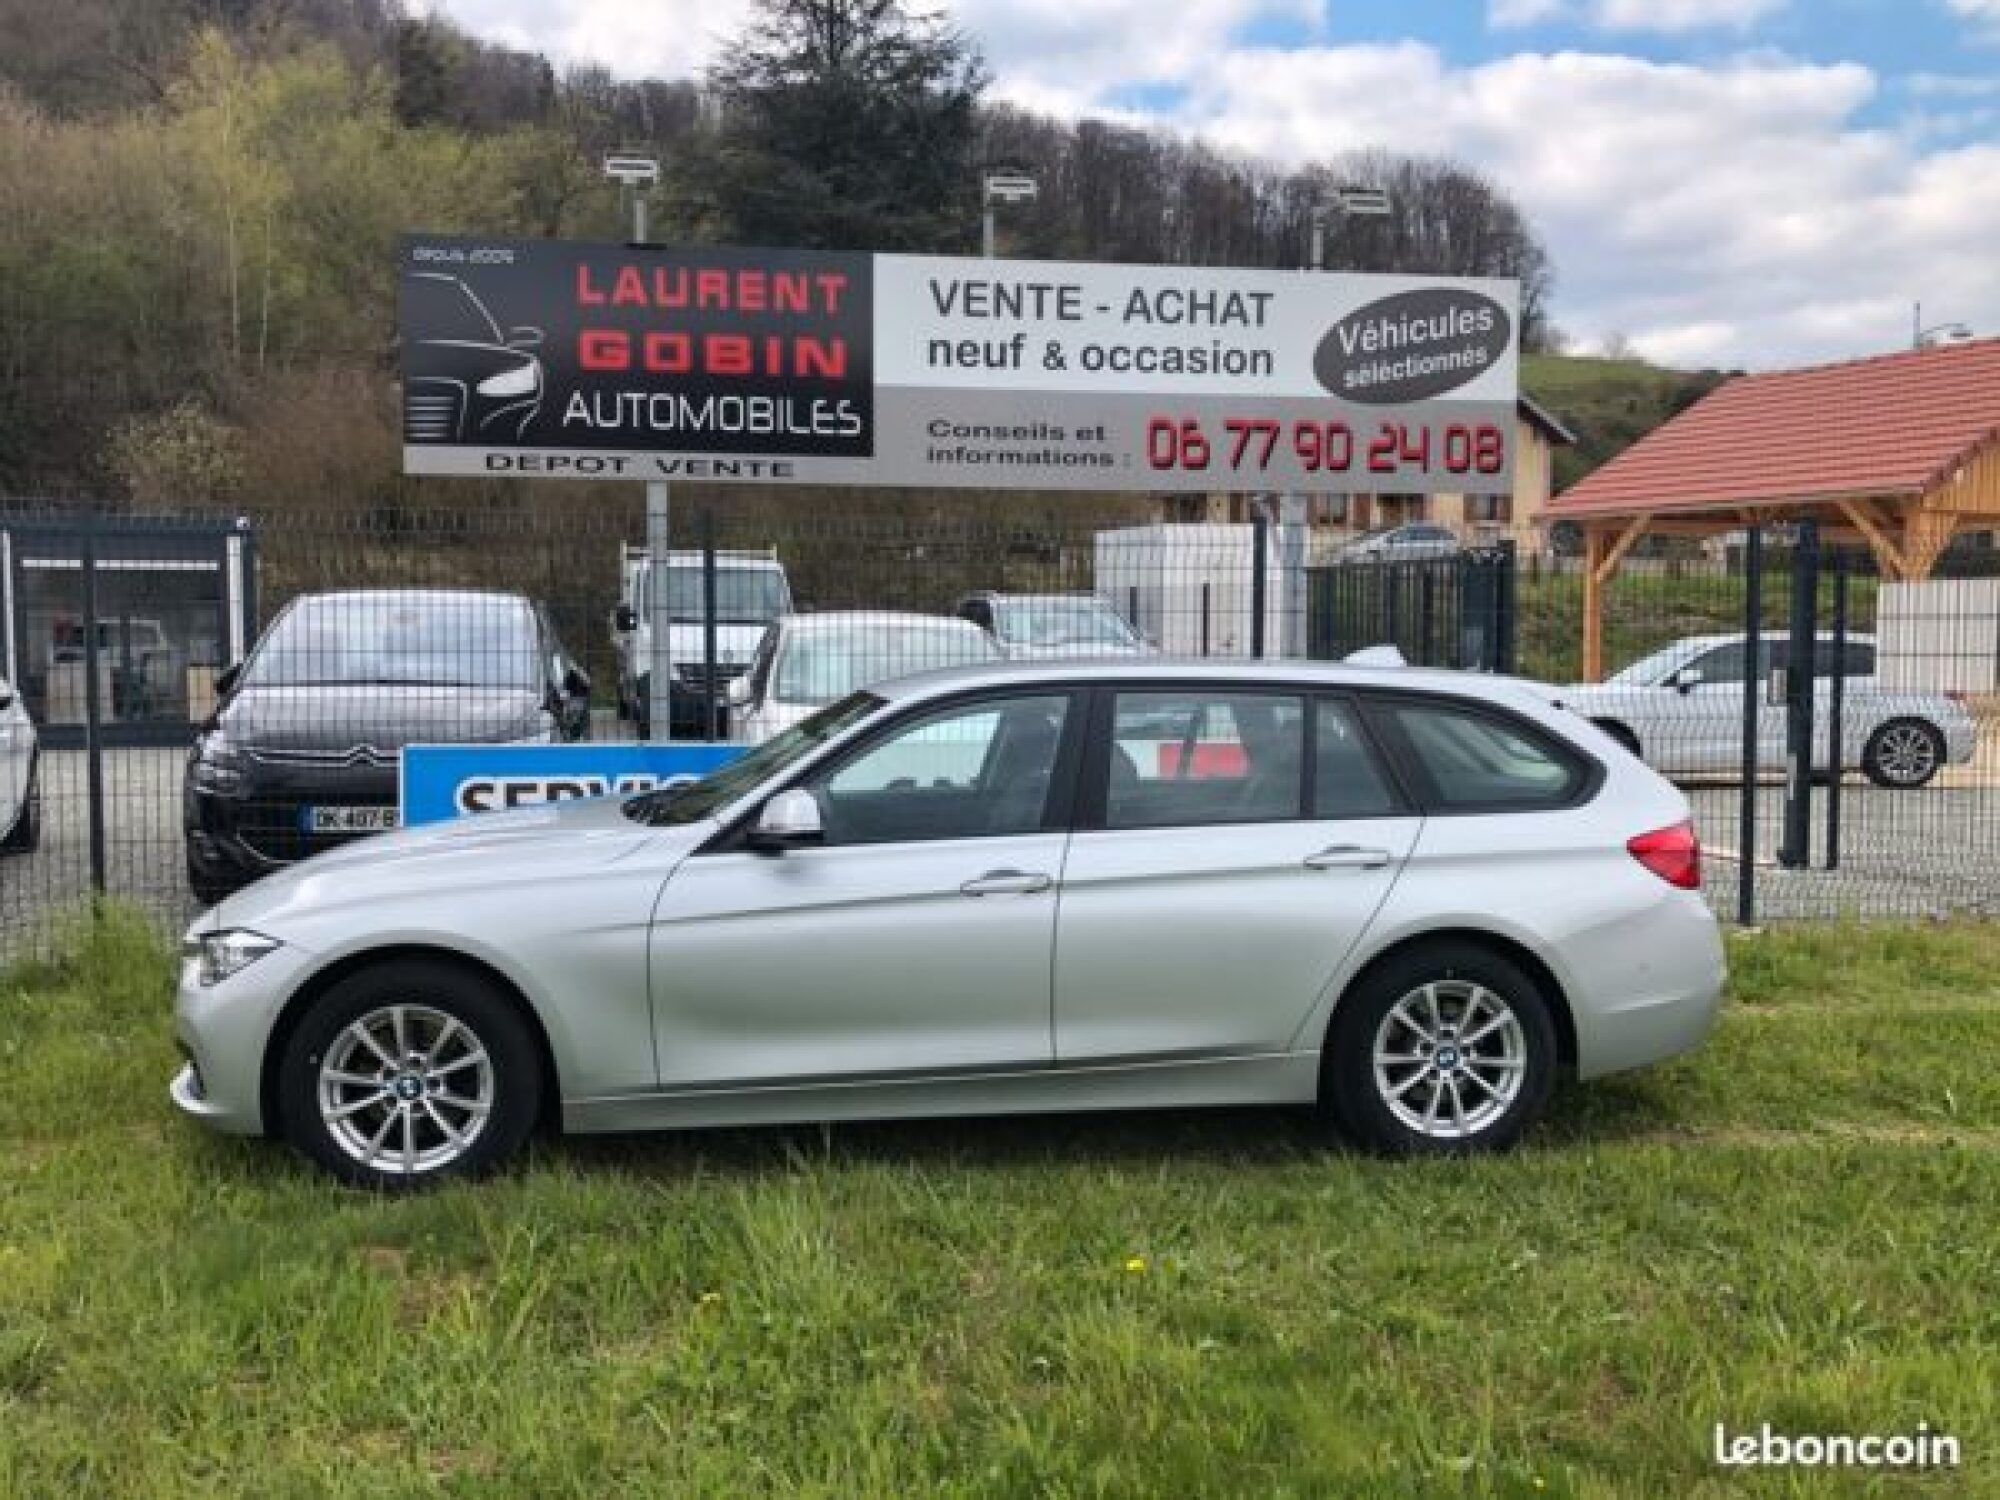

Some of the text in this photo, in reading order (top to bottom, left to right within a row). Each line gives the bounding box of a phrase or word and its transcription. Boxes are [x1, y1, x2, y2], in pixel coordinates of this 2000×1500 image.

[577, 264, 847, 315] LAURENT
[929, 279, 1083, 322] VENTE
[1123, 287, 1274, 329] ACHAT
[578, 328, 847, 379] GOBIN
[1338, 305, 1494, 355] Véhicules
[928, 331, 1275, 378] neuf & occasion
[562, 390, 861, 436] AUTOMOBILES
[927, 418, 1105, 441] Conseils et
[485, 452, 795, 478] DEPOT VENTE
[927, 445, 1114, 468] informations
[1147, 415, 1505, 475] 06 77 90 24 08
